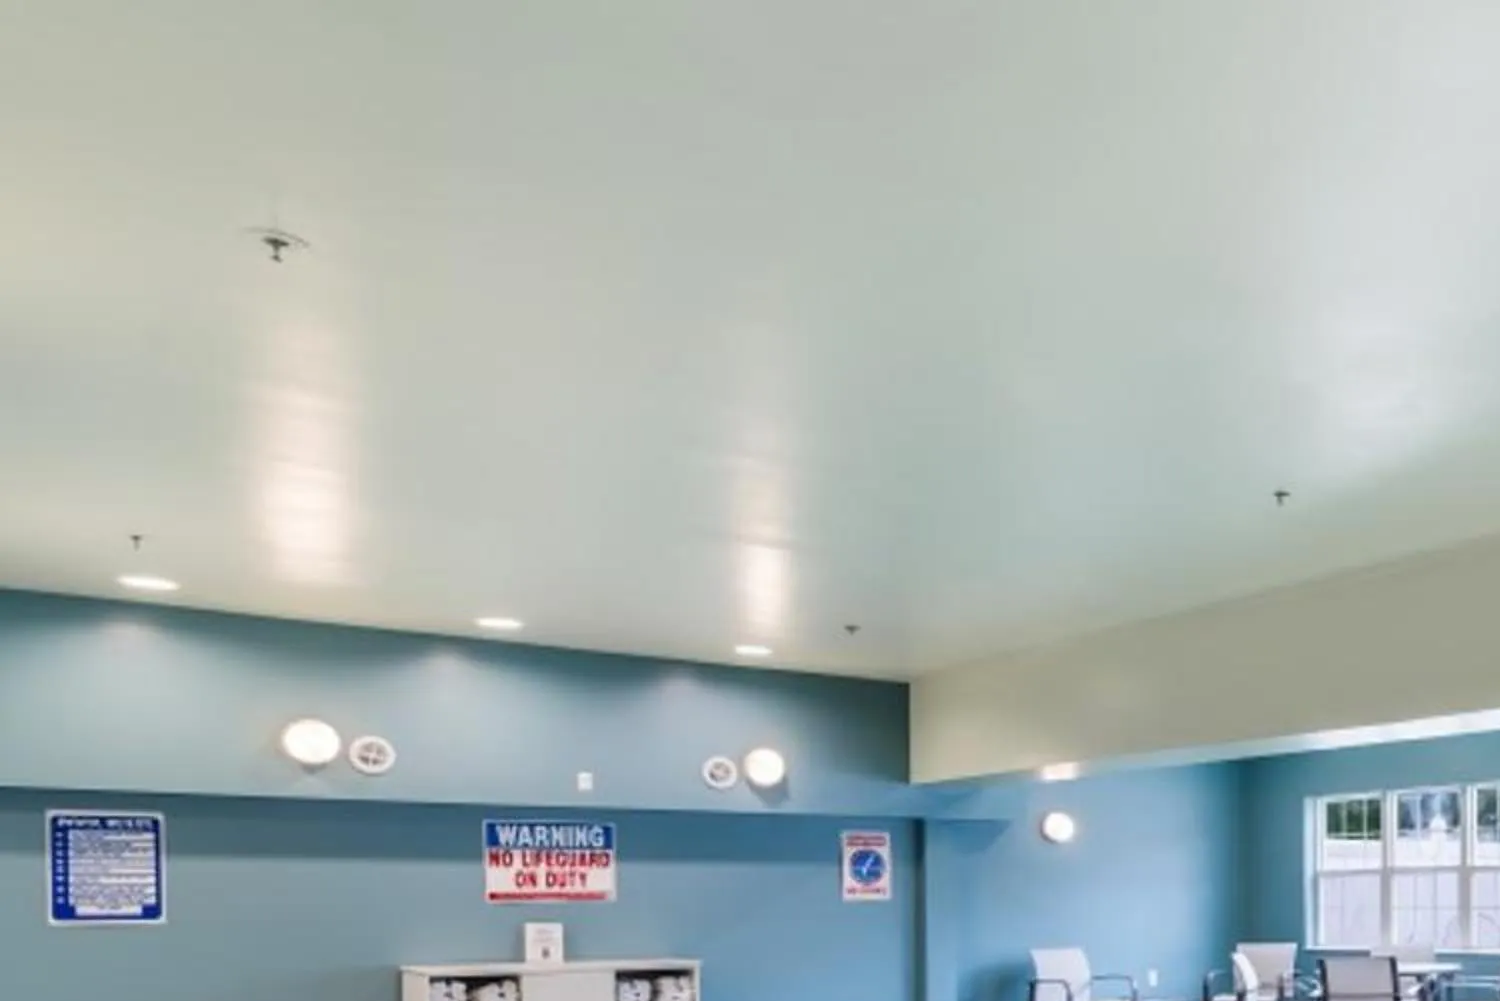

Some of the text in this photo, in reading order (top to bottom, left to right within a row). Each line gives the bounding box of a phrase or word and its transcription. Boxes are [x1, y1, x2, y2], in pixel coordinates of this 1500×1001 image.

[495, 823, 606, 848] WARNING
[488, 850, 610, 868] NO LIFEGUARD
[515, 871, 588, 888] ON DUTY
